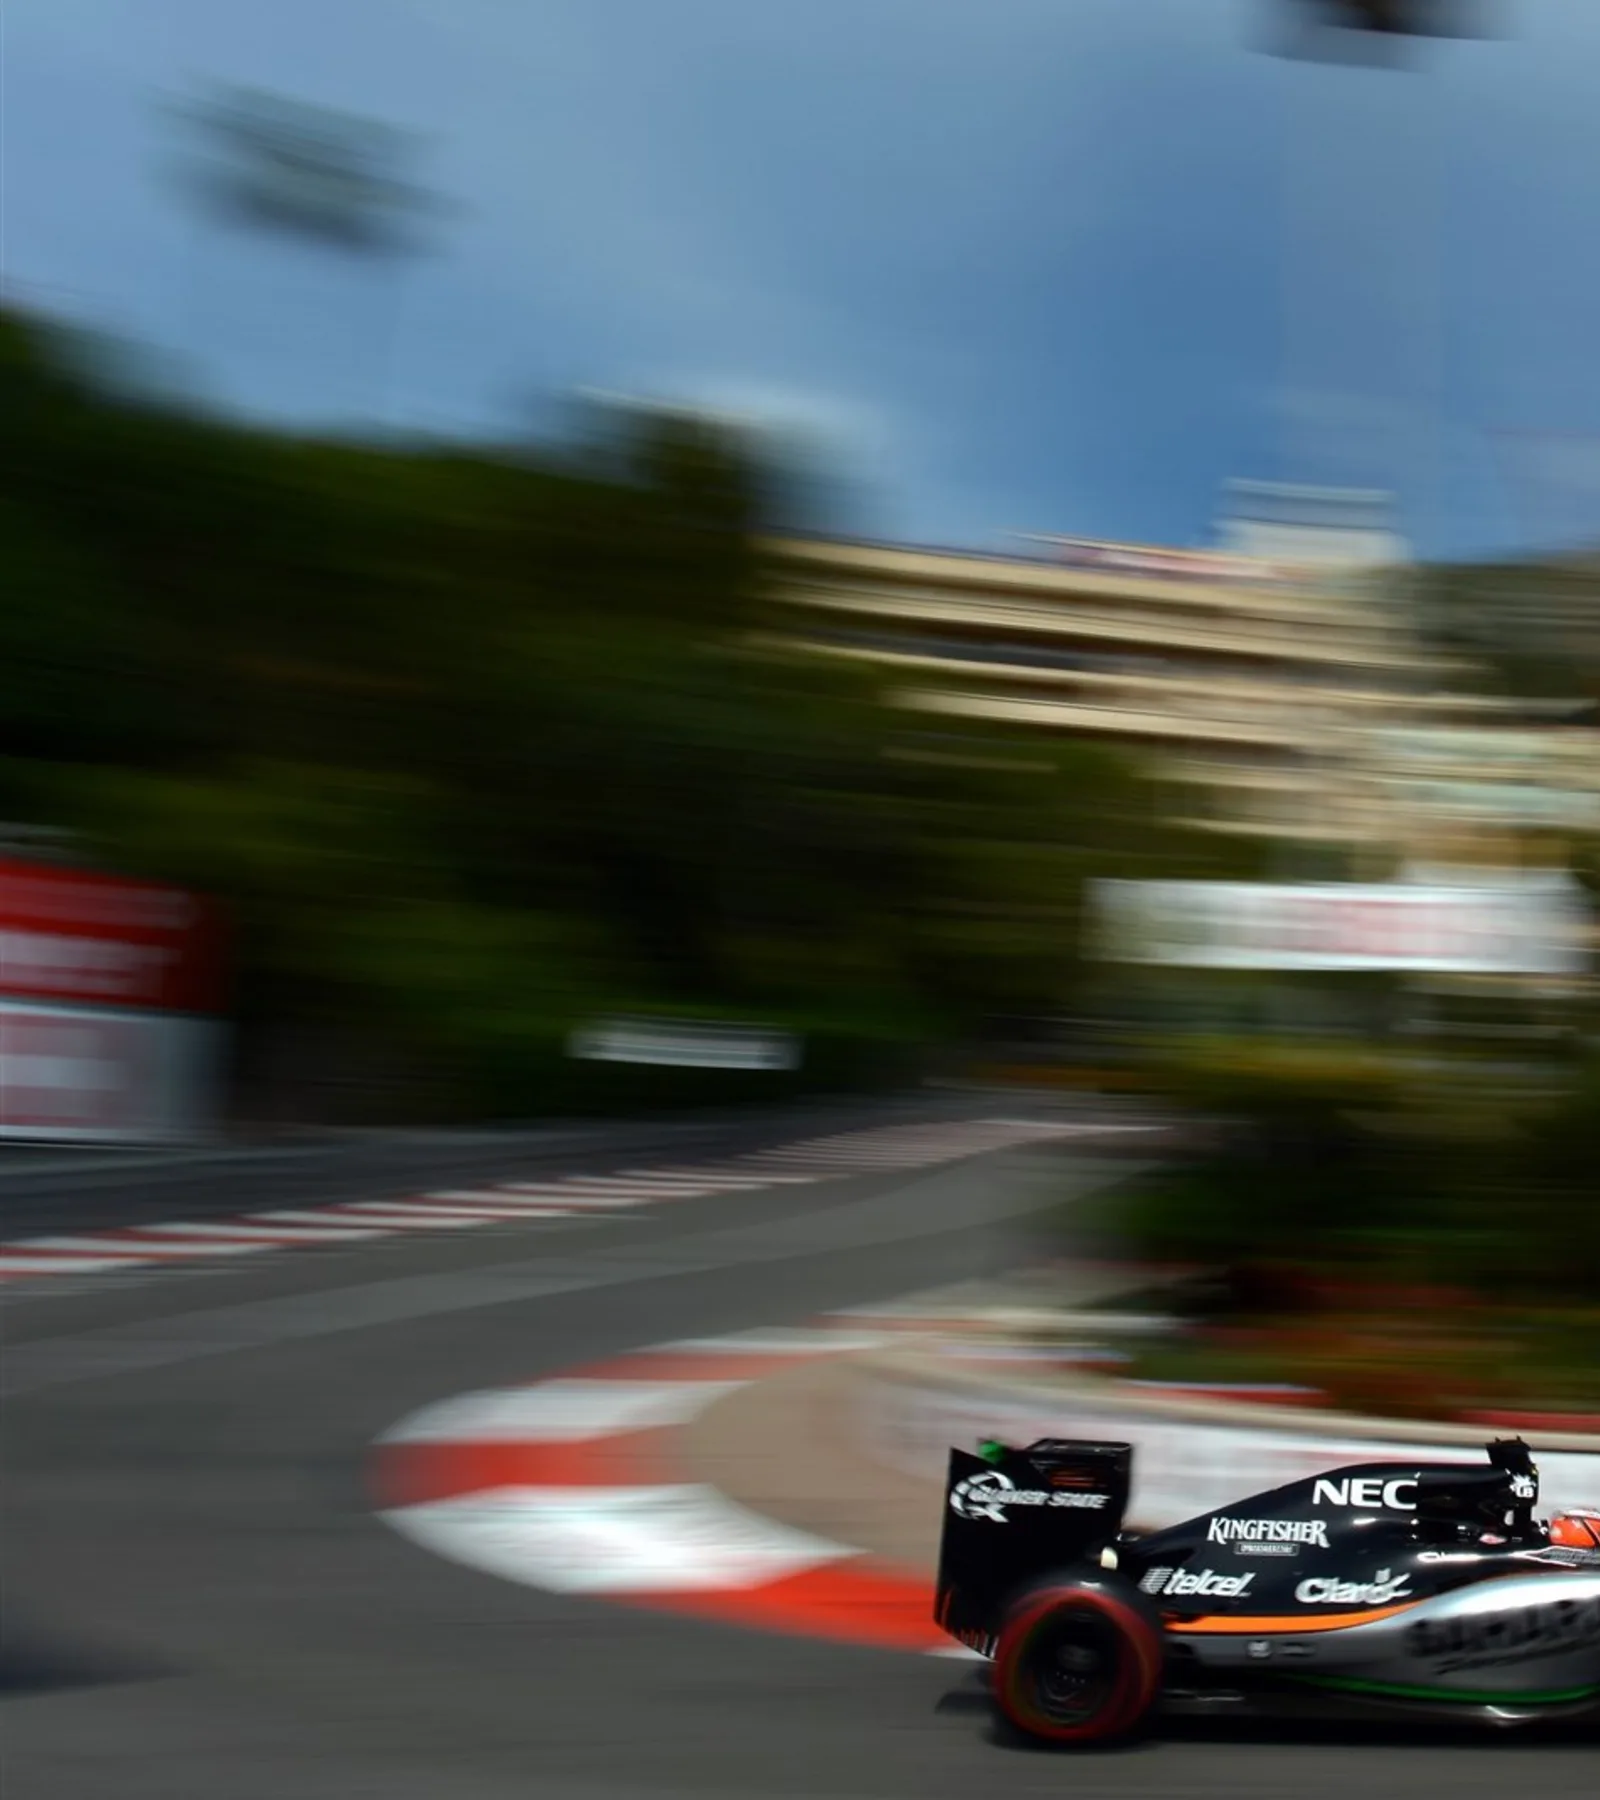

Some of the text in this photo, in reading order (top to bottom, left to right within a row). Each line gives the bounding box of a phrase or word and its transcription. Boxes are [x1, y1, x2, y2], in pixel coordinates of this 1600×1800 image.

[1312, 1478, 1418, 1510] NEC
[1206, 1517, 1330, 1549] KINGFISHER
[1163, 1569, 1256, 1597] telcel
[1295, 1569, 1412, 1604] Claro
